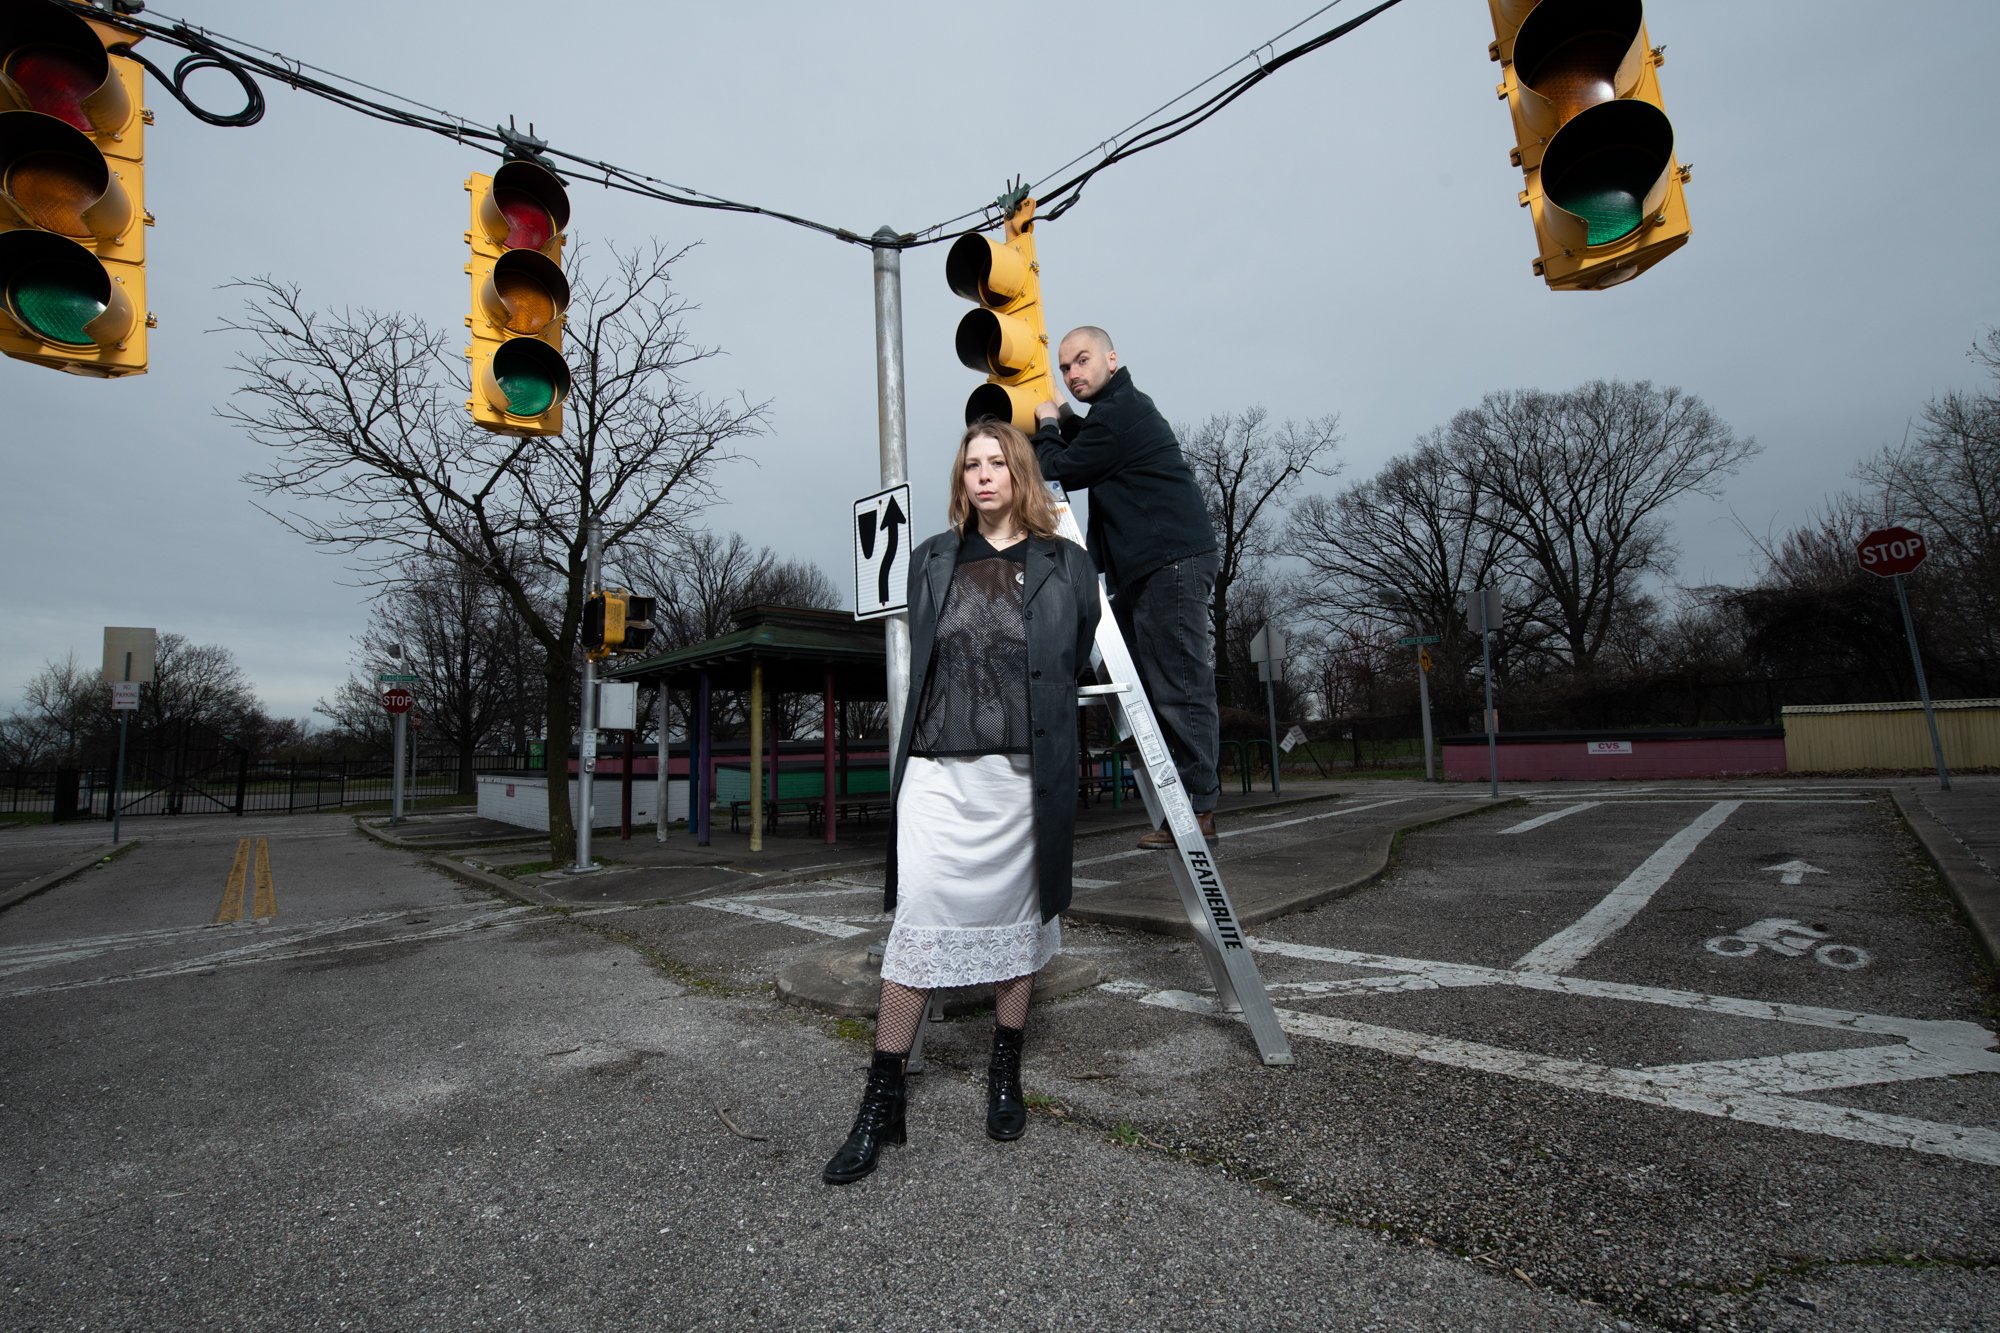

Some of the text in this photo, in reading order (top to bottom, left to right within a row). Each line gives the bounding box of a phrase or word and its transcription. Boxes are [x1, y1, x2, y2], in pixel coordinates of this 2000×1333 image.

[1862, 538, 1922, 565] STOP
[382, 695, 413, 707] STOP
[1598, 742, 1620, 750] CVS
[1188, 851, 1243, 949] FEATHERLITE
